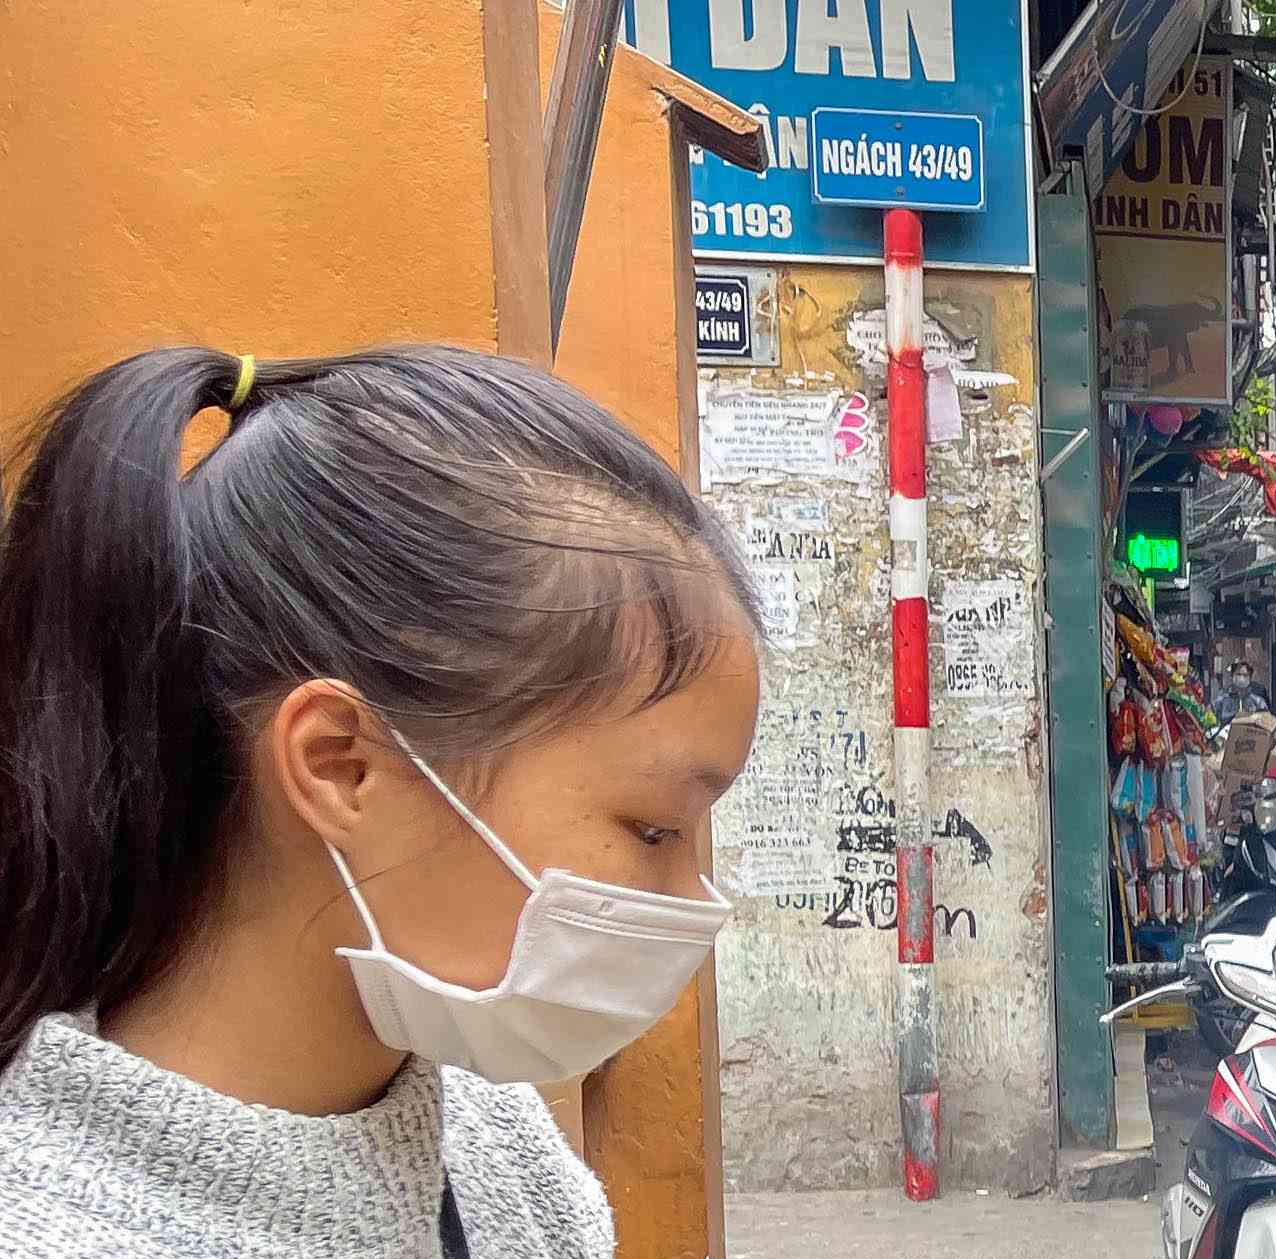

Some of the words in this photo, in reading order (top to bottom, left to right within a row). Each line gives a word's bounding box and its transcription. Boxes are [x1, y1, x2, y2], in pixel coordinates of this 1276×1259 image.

[822, 133, 903, 178] NGÁCH
[907, 142, 973, 182] 43/49
[691, 199, 794, 240] 61193
[1161, 191, 1224, 234] DÂN
[698, 316, 741, 342] KÍNH
